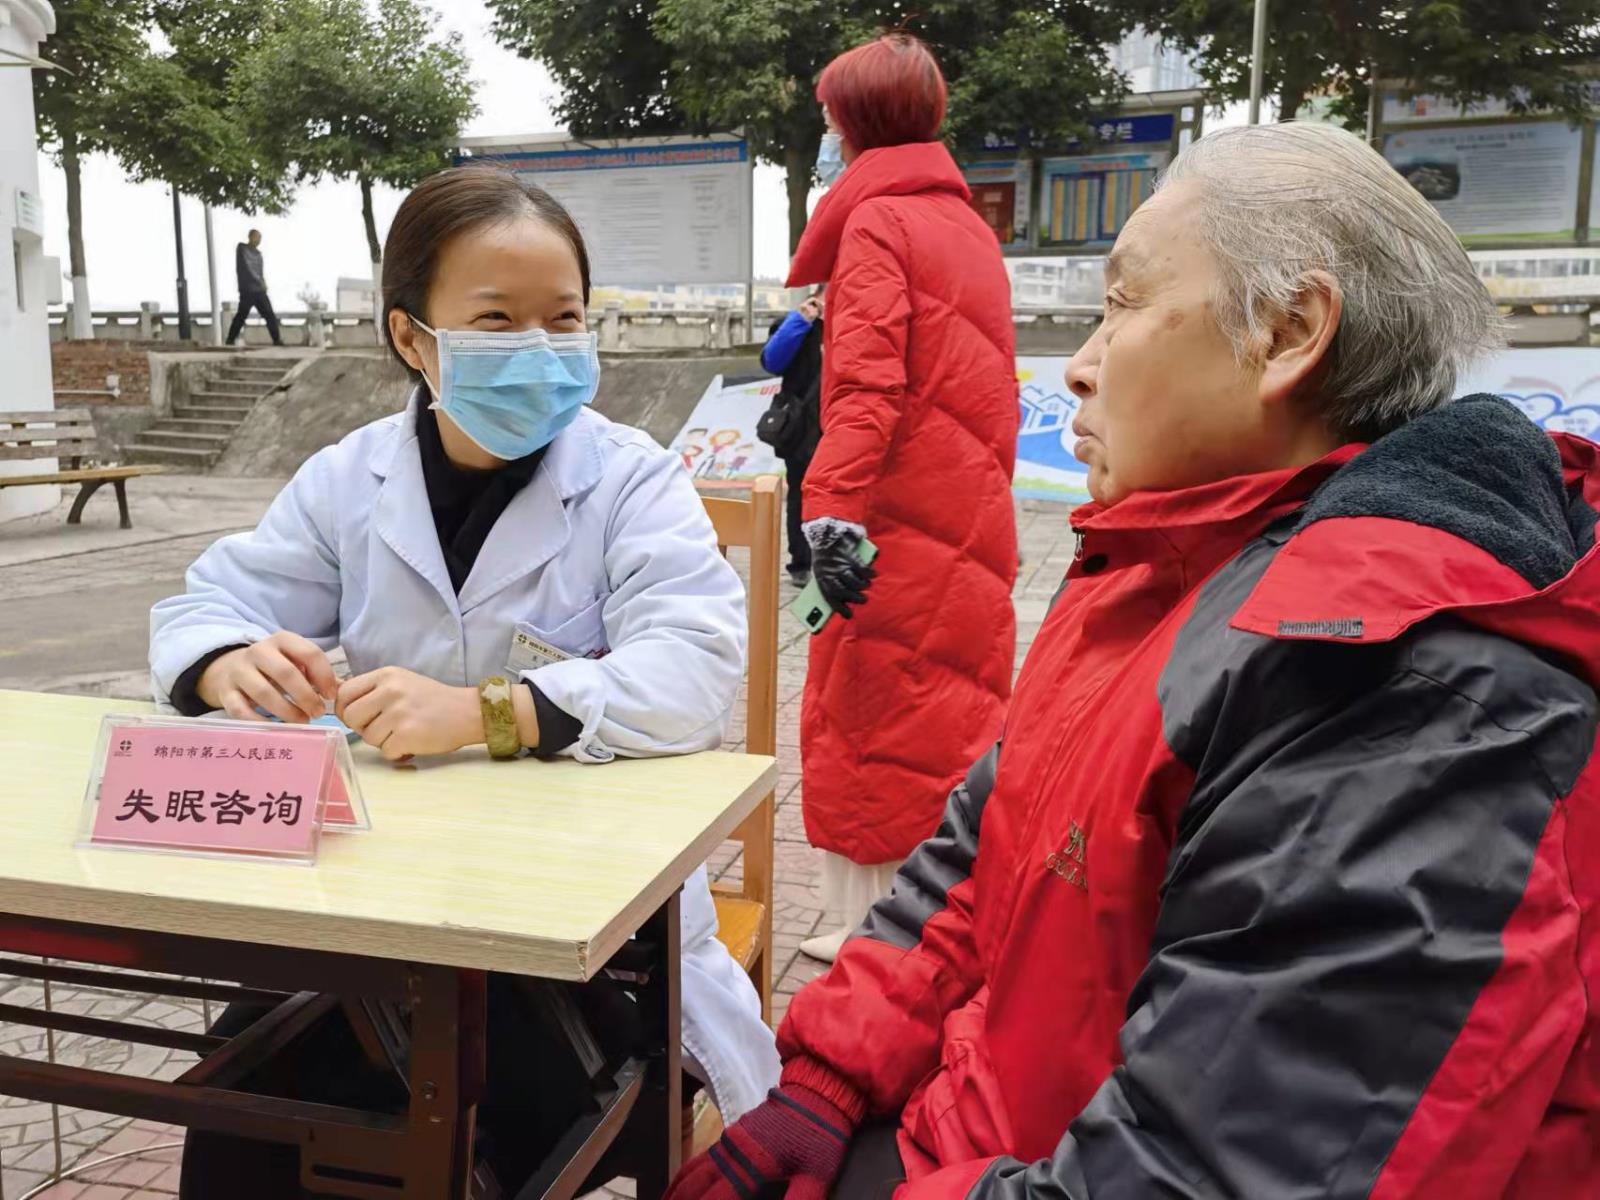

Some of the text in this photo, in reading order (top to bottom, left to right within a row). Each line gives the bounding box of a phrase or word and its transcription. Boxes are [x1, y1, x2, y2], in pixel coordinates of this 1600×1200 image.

[154, 745, 293, 760] 绵阳市第三人民医院
[115, 788, 303, 826] 失眠咨询
